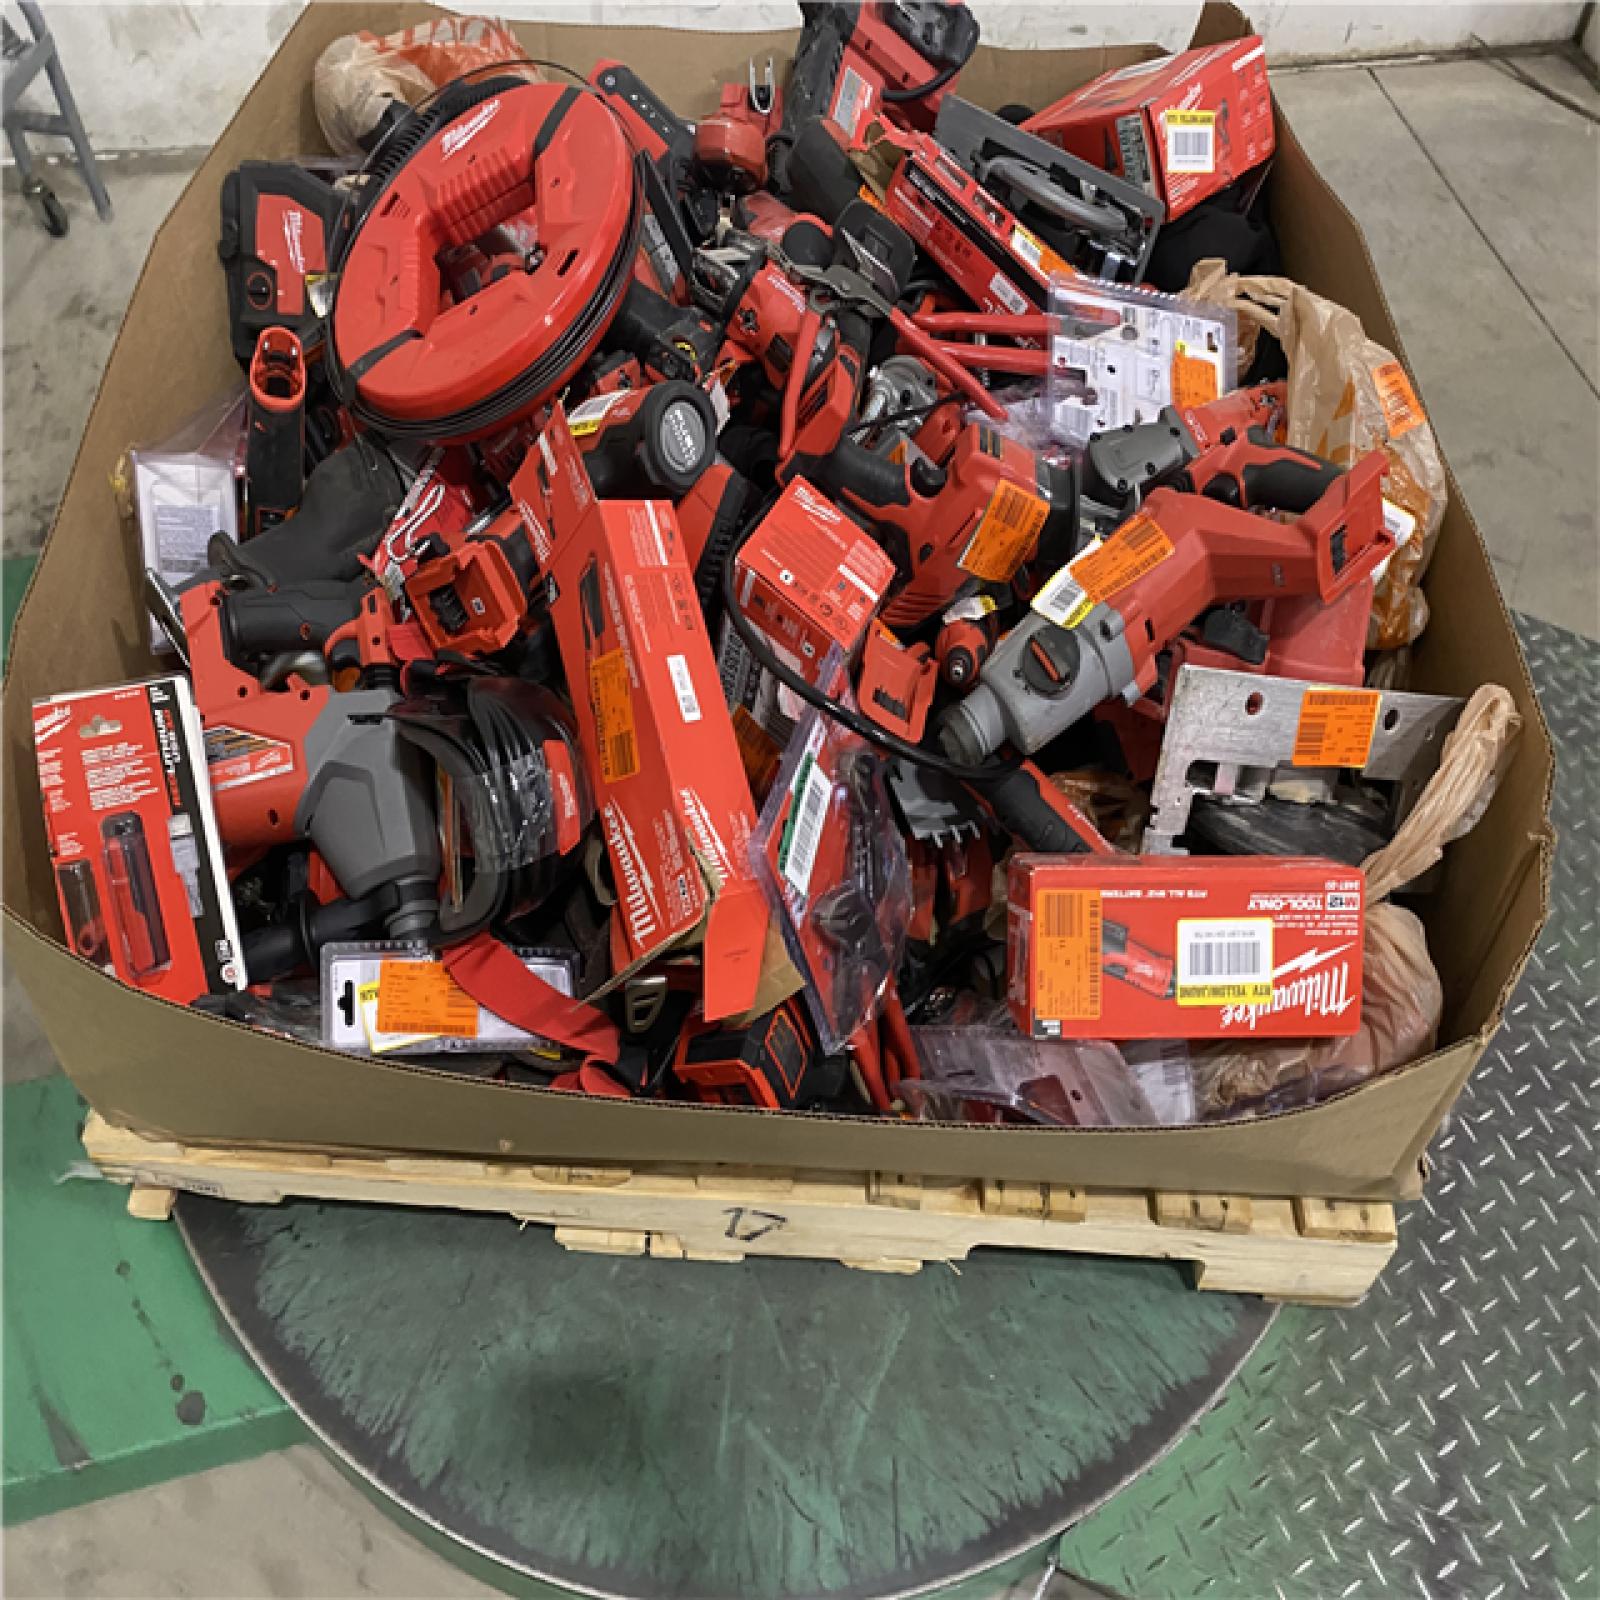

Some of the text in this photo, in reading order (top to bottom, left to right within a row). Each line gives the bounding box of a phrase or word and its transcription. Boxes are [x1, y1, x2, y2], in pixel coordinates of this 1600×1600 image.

[1247, 896, 1324, 911] TOOL-ONLY
[1219, 960, 1355, 1030] Milwaukee
[721, 1207, 788, 1242] 17
